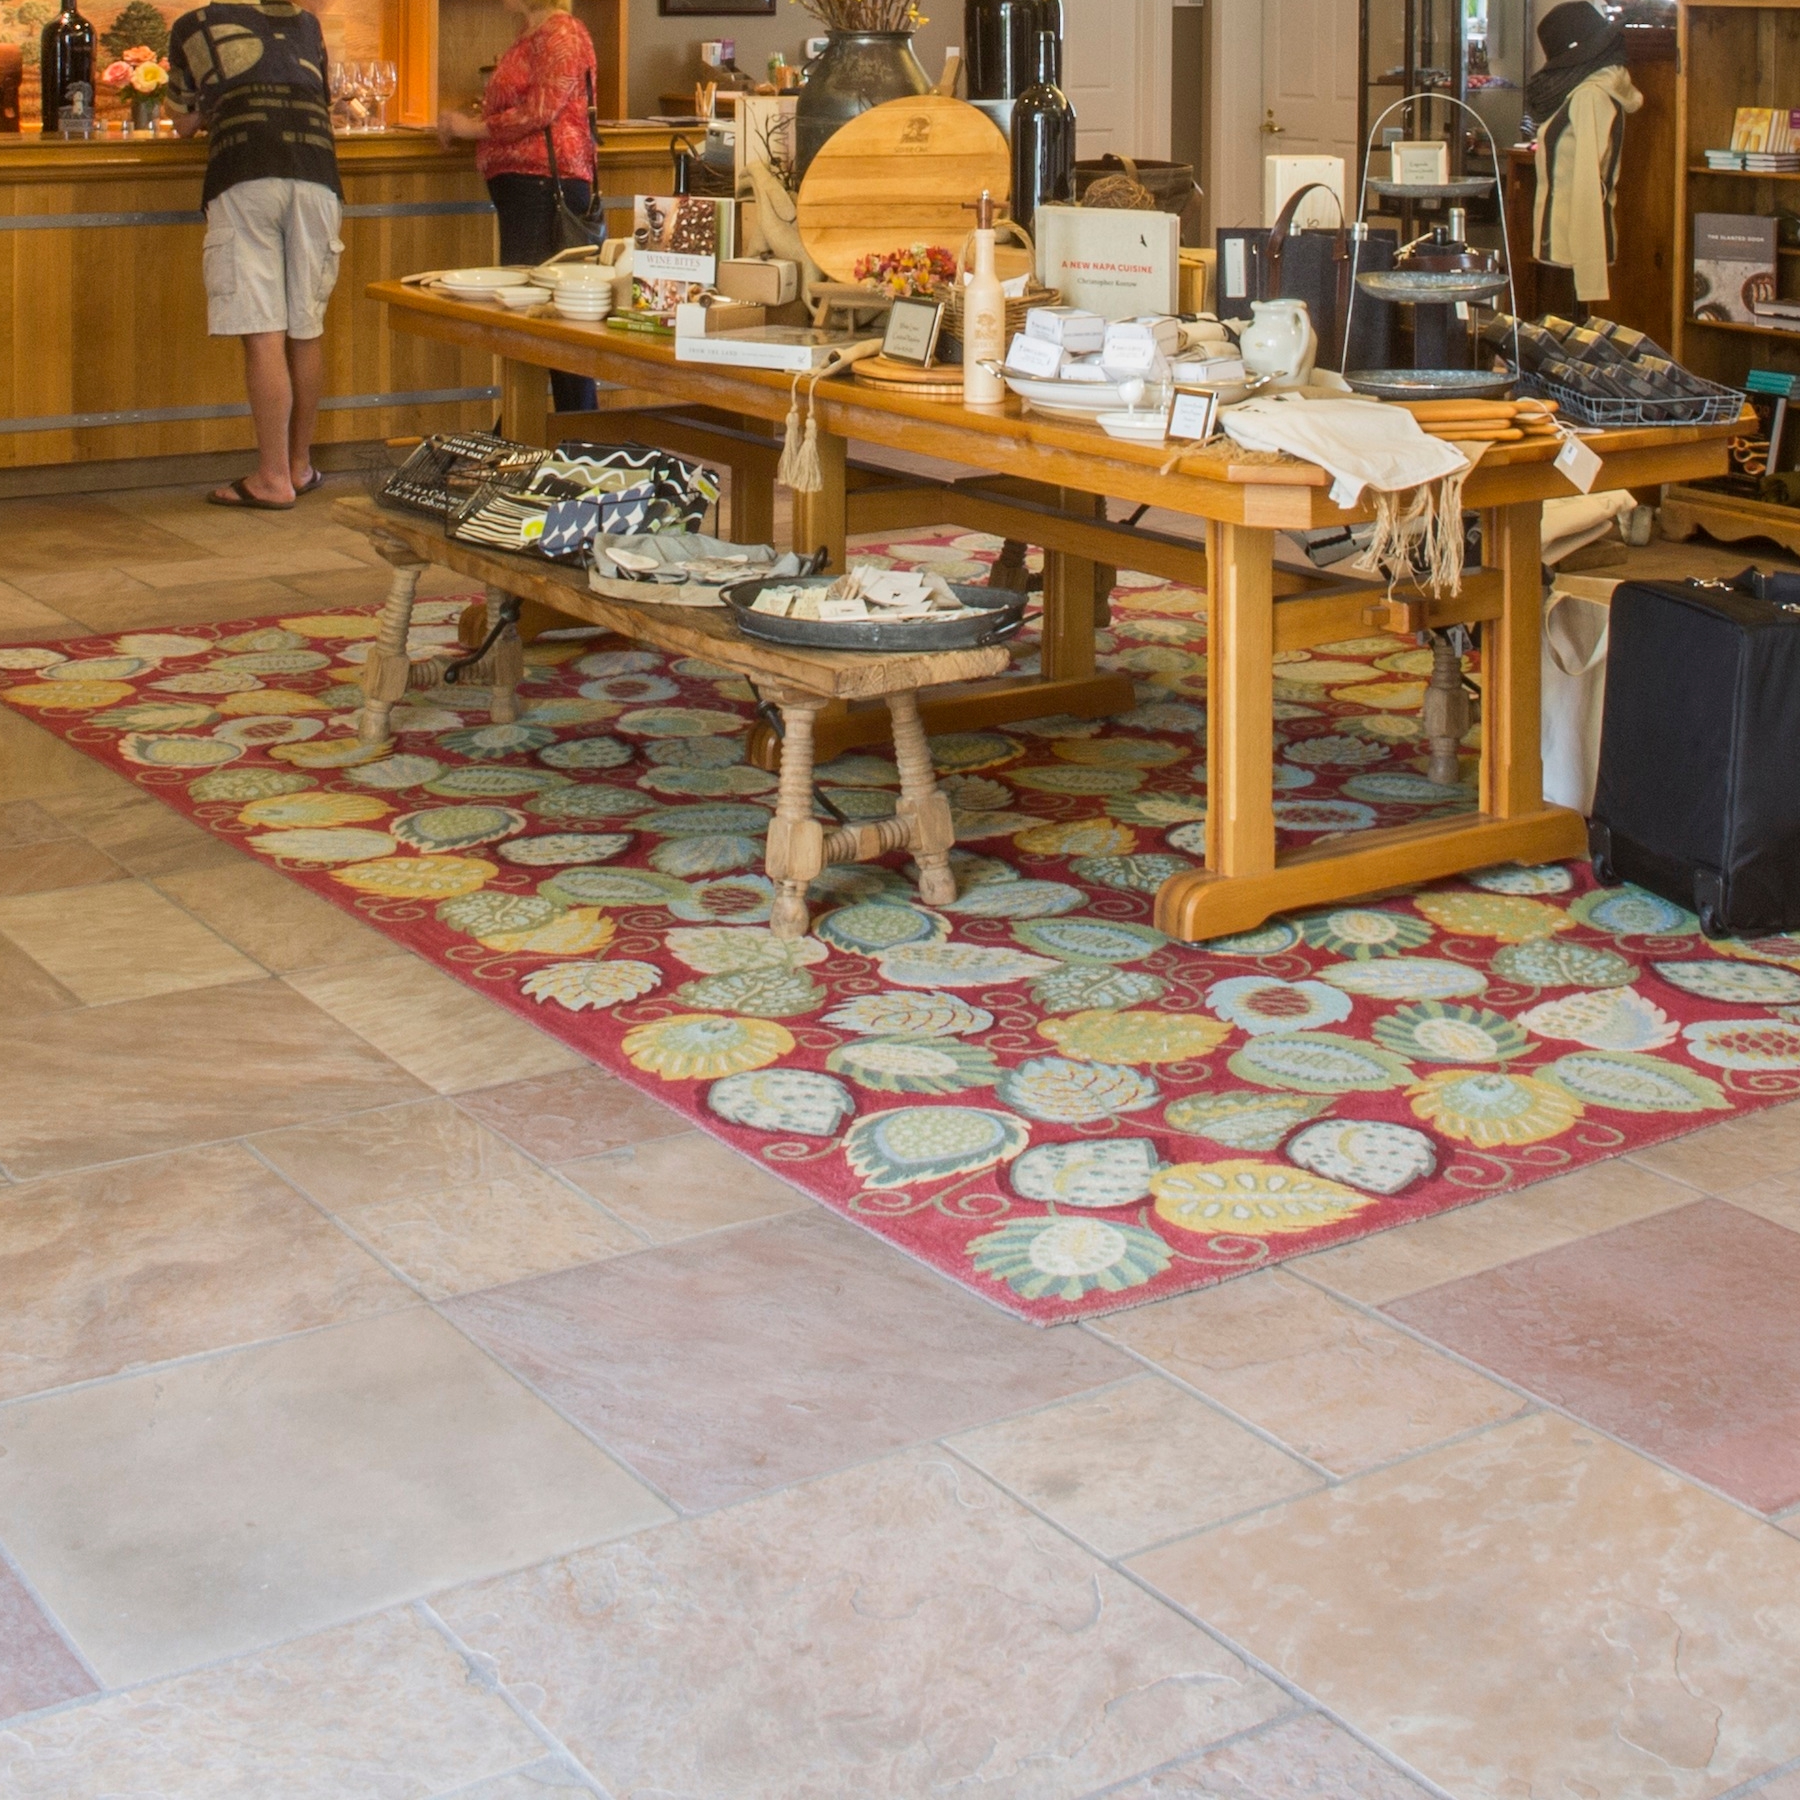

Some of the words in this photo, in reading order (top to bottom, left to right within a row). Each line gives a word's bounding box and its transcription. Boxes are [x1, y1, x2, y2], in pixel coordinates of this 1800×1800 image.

[646, 255, 671, 265] WINE
[674, 256, 701, 267] BITES
[1061, 260, 1068, 268] A
[1070, 261, 1090, 270] NEW
[1092, 262, 1116, 271] NAPA
[1118, 263, 1153, 274] CUISINE
[1077, 277, 1114, 288] Christopher
[441, 443, 466, 456] SILVER
[466, 450, 485, 460] OAK
[451, 437, 477, 449] SILVER
[477, 444, 494, 453] OAK
